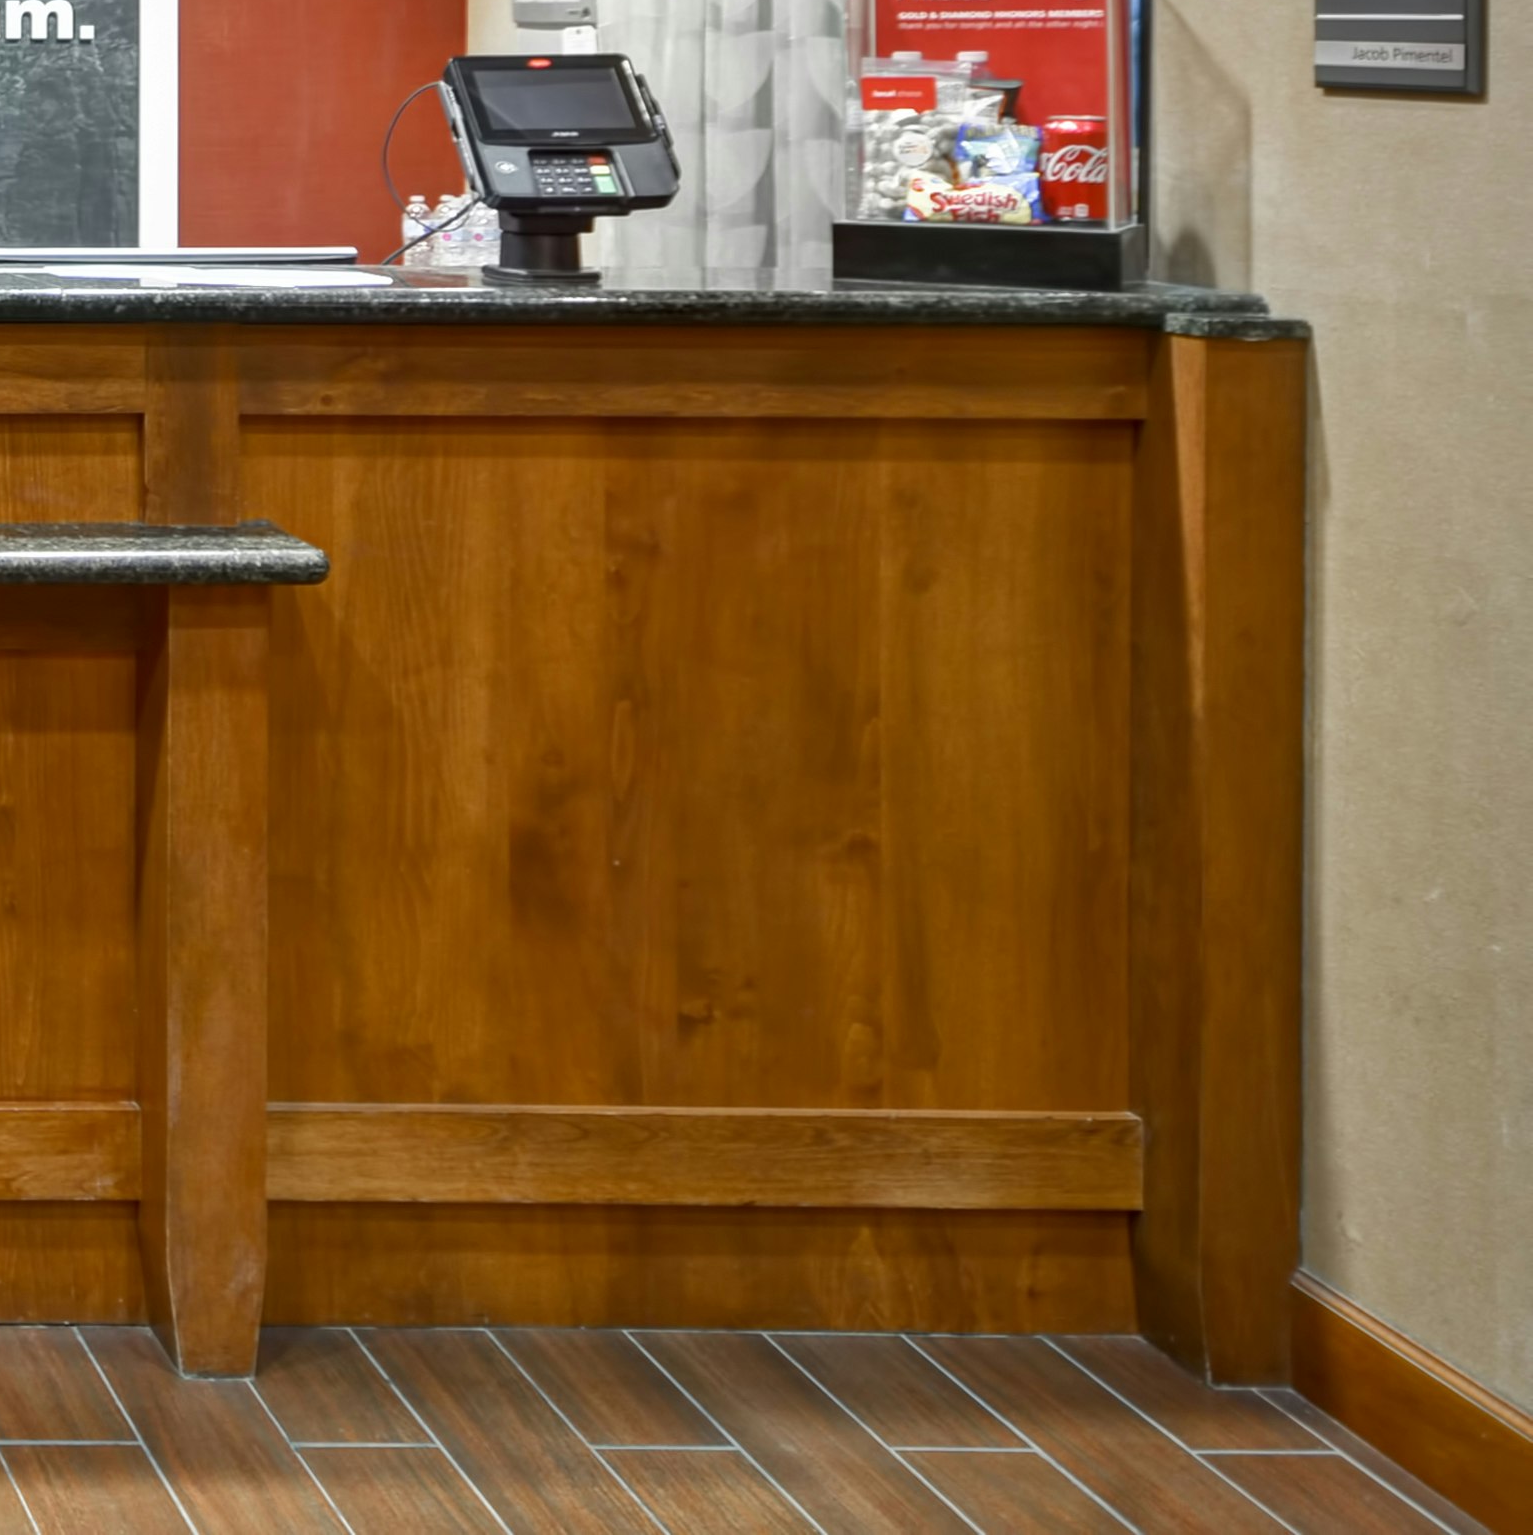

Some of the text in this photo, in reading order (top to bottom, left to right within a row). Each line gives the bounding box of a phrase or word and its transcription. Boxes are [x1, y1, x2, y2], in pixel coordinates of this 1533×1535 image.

[1352, 47, 1453, 63] Jacob Pimentel
[930, 192, 1018, 213] Swedish
